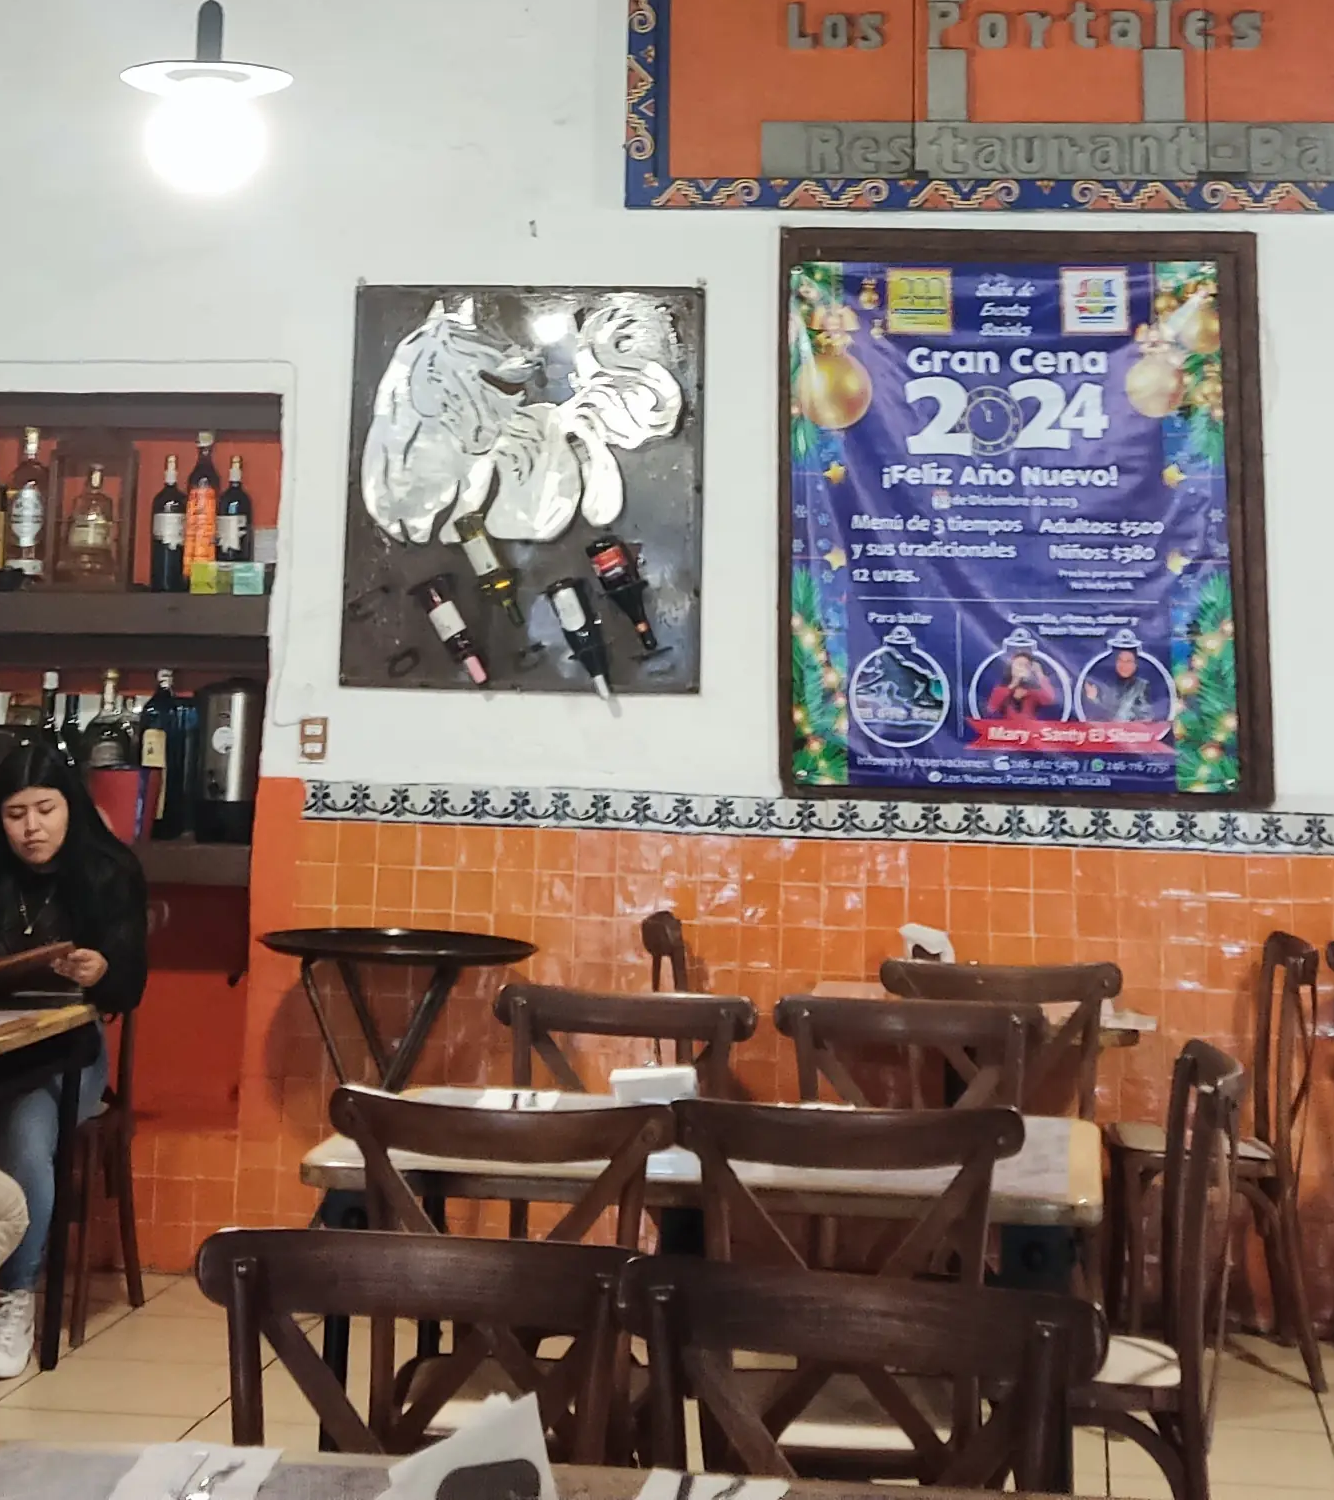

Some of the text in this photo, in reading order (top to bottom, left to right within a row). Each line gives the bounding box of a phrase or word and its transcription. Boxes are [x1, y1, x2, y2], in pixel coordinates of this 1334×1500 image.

[784, 0, 886, 51] Los
[907, 347, 1108, 375] Gran Cena
[882, 463, 1119, 489] ¡Feliz Año Nuevo!
[851, 514, 1024, 536] Menú de 3 tiempos
[1039, 518, 1165, 537] Adultos: $500
[851, 541, 1017, 559] y sus tradicionales
[1110, 544, 1156, 564] $380
[851, 568, 870, 583] 12
